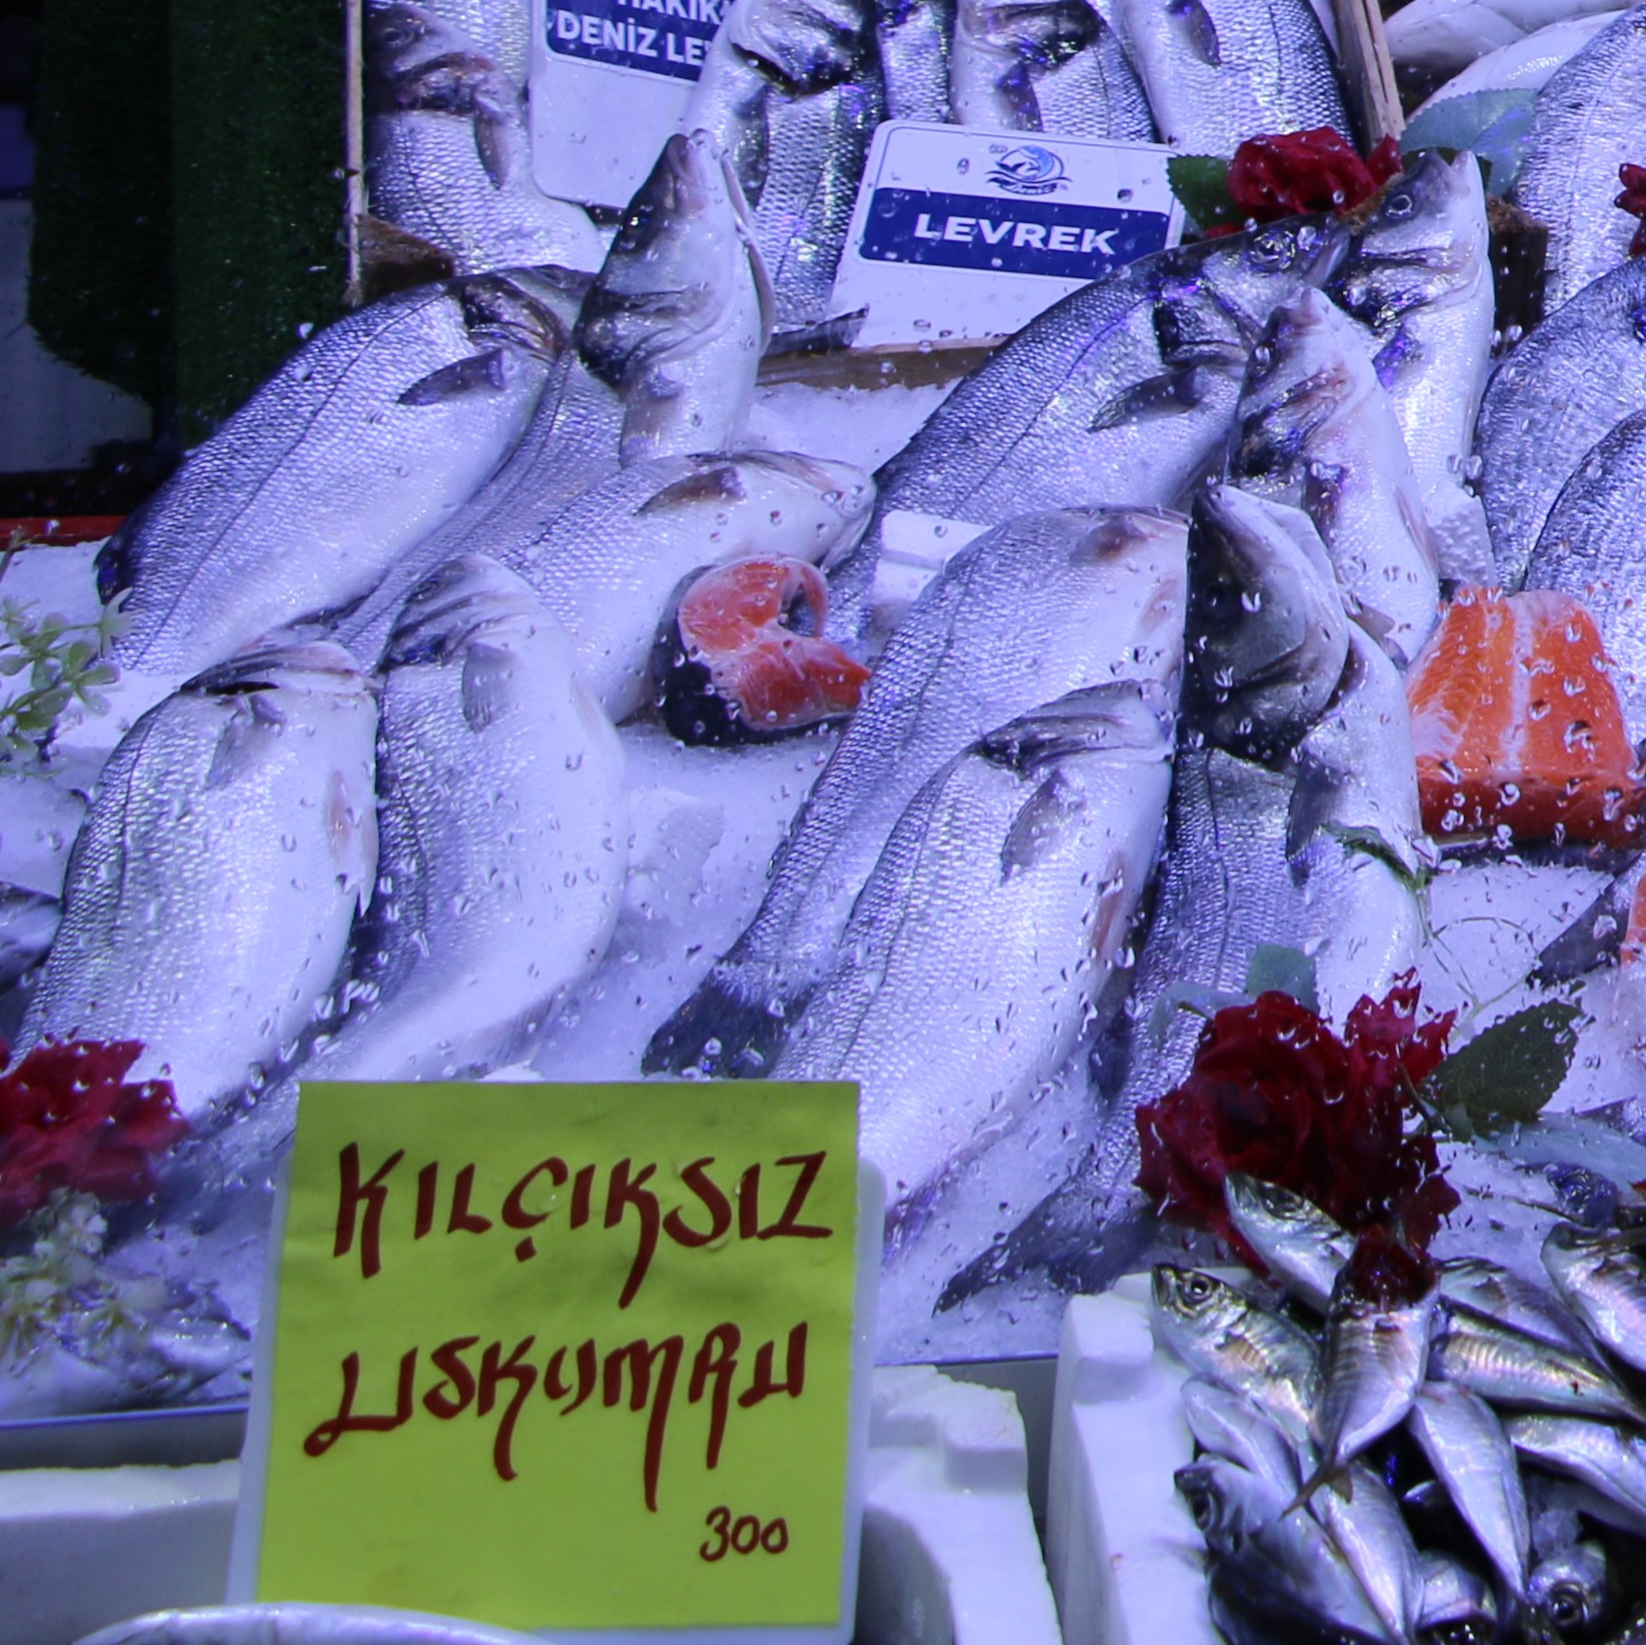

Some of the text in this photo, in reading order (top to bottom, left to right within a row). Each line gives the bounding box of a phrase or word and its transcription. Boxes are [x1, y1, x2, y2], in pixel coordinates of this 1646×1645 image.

[557, 9, 658, 58] DENİZ
[914, 213, 1119, 255] LEVREK
[333, 1142, 833, 1310] KILÇIKSIZ
[699, 1505, 790, 1562] 300
